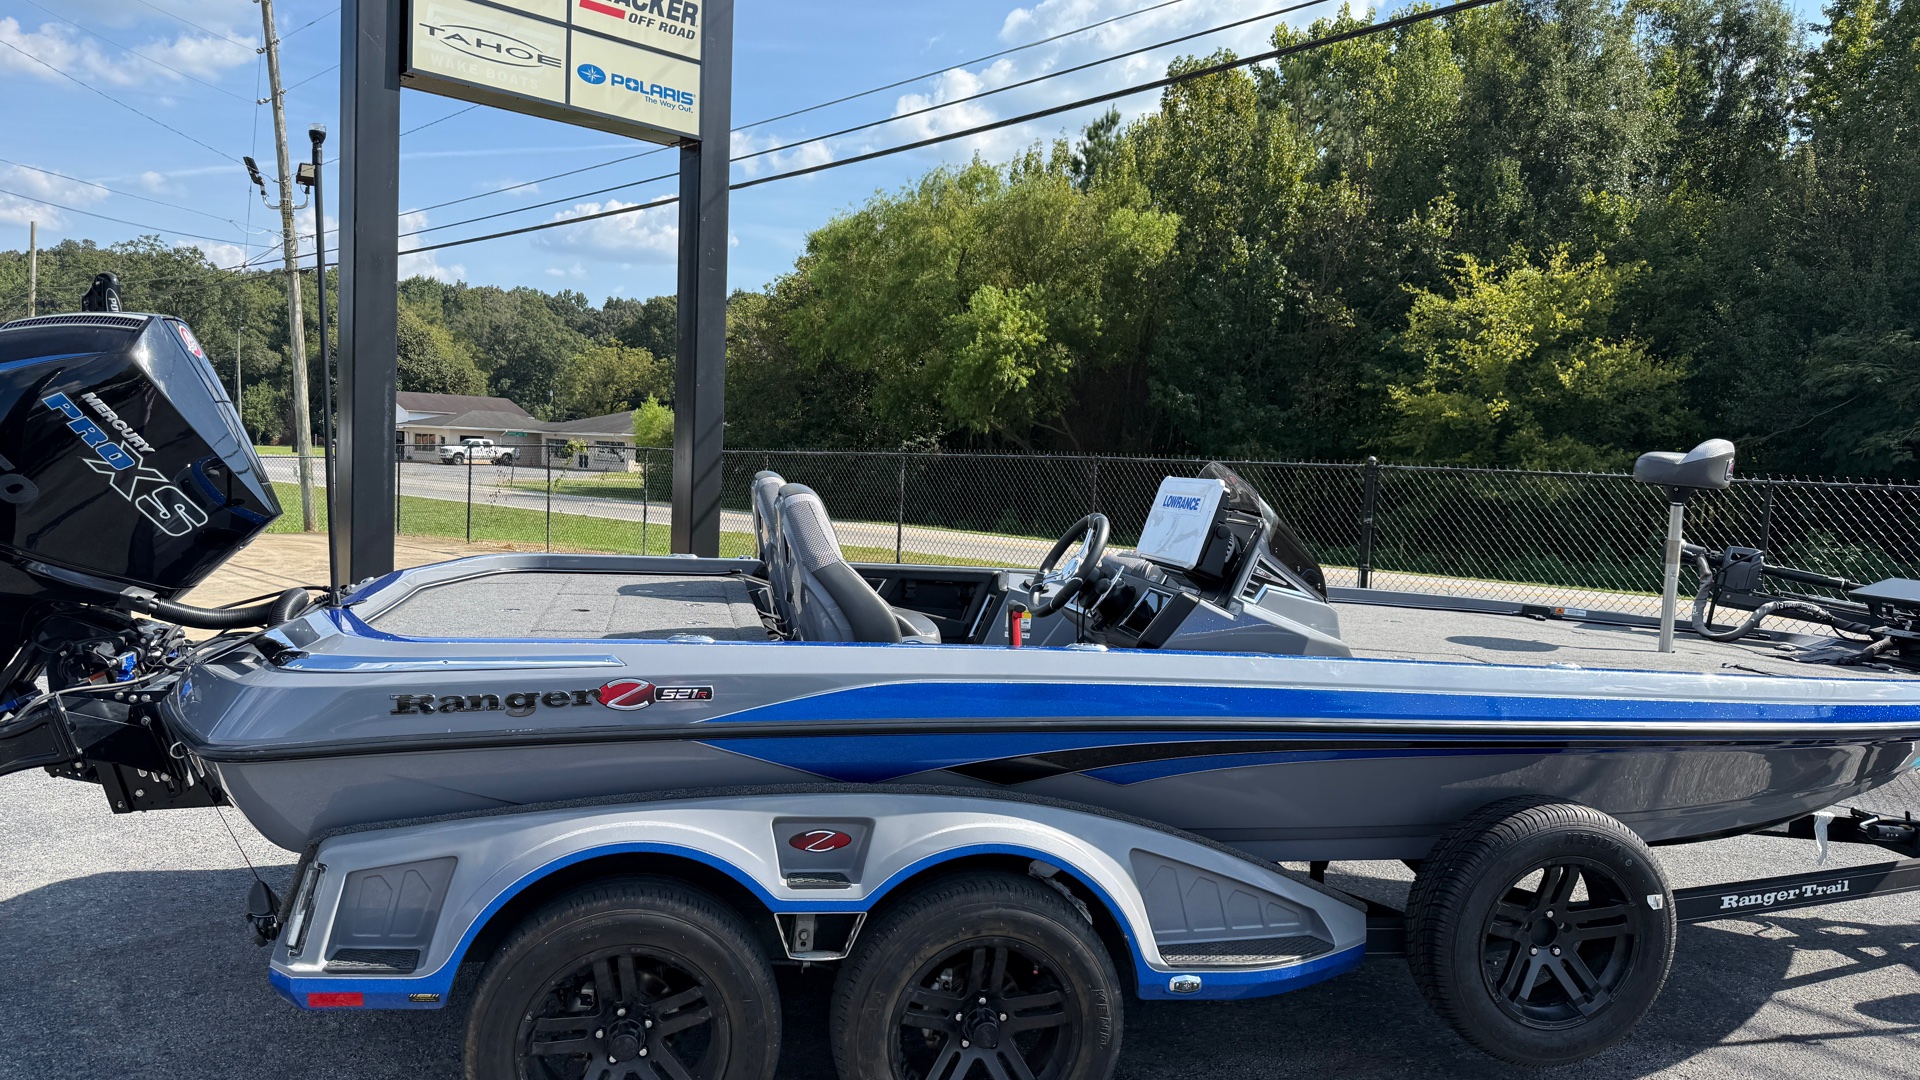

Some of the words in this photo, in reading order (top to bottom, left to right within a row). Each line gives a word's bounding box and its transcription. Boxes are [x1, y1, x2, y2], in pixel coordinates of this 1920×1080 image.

[628, 13, 656, 28] OFF
[658, 22, 696, 40] ROAD
[419, 23, 562, 68] TAHOE
[430, 53, 479, 76] WAKE
[485, 68, 540, 90] BOATS
[611, 73, 694, 106] POLARIS
[645, 96, 658, 105] The
[659, 99, 677, 110] Way
[677, 104, 694, 113] Out.
[41, 391, 136, 471] PRO
[81, 392, 156, 453] MERCURY
[82, 440, 208, 537] XS
[1162, 494, 1201, 511] LOWRANCE
[389, 689, 602, 718] Ranger
[1564, 832, 1622, 854] KENDA
[1720, 888, 1800, 909] Ranger
[1801, 880, 1850, 898] Trail
